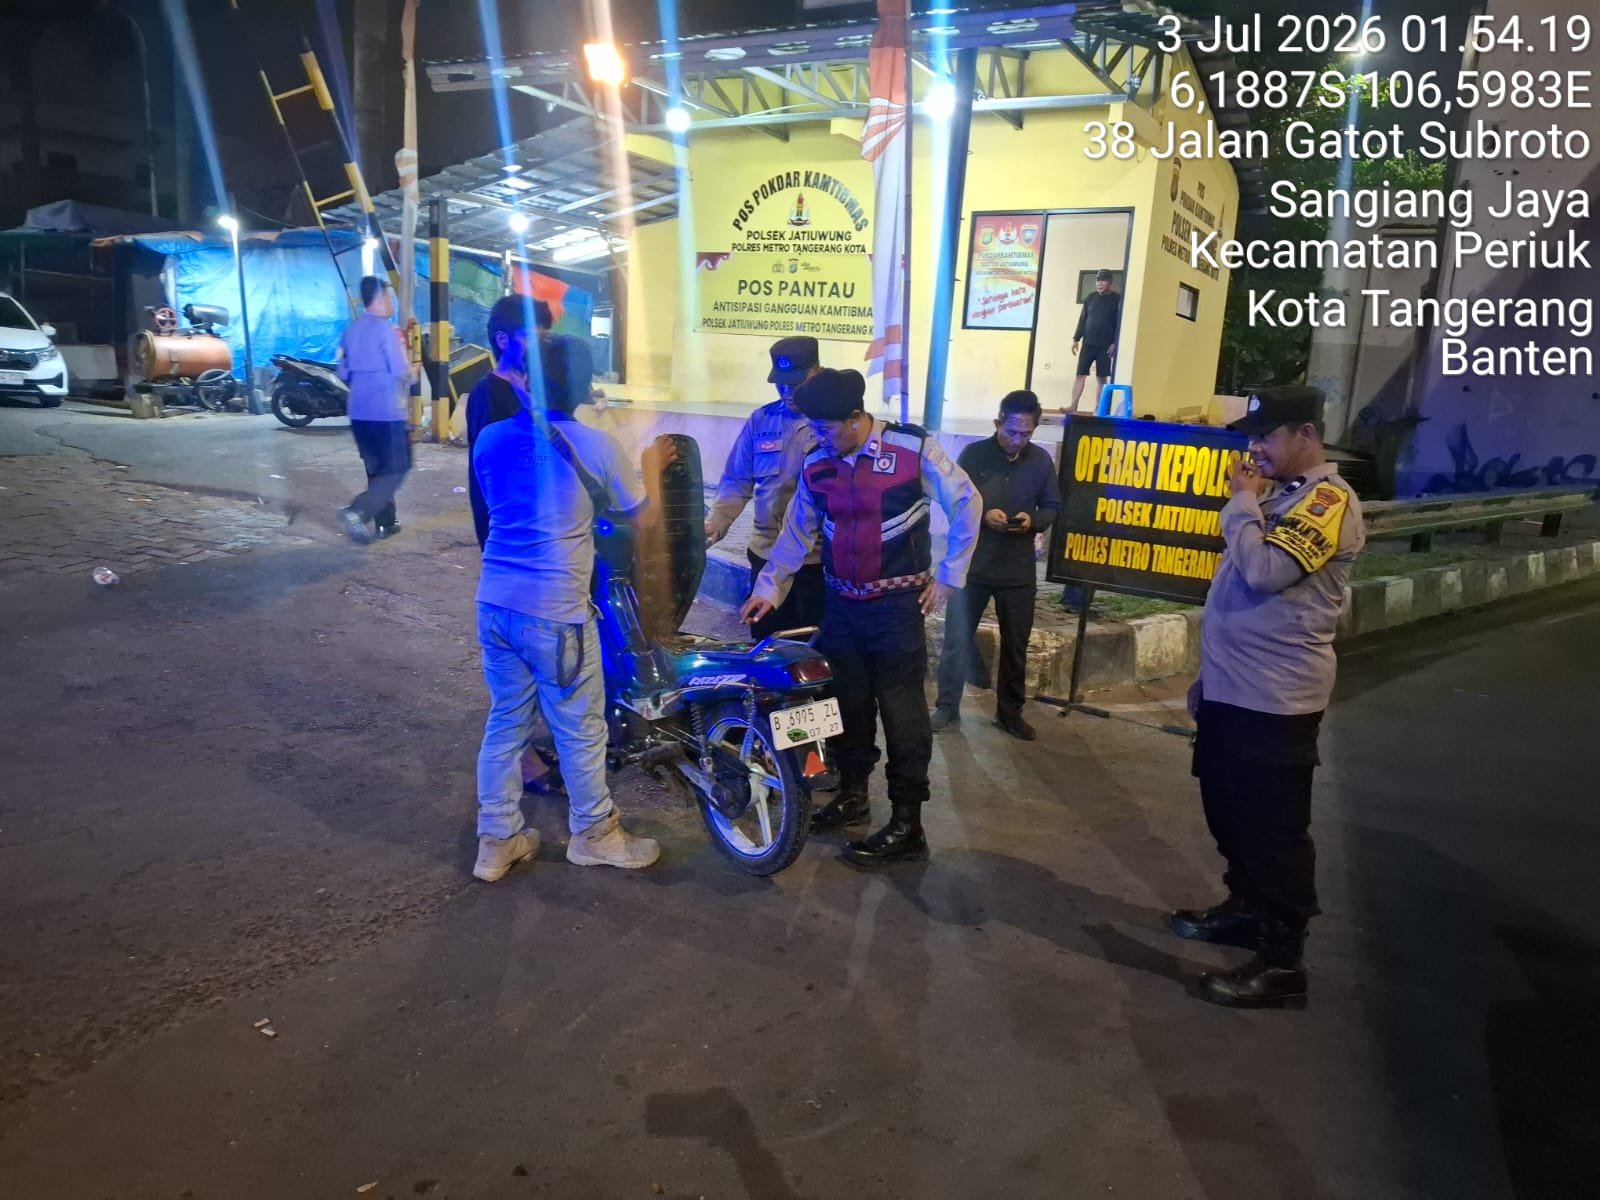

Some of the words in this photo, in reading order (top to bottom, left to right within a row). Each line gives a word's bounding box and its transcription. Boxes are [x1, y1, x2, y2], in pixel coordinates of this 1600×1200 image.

[732, 199, 754, 231] POS
[752, 170, 800, 206] POKDAR
[746, 230, 786, 241] POLSEK
[788, 230, 852, 242] JATIUWUNG
[732, 242, 761, 252] POLRES
[762, 243, 791, 253] METRO
[792, 243, 843, 254] TANGERANG
[844, 243, 867, 254] KOTA
[738, 279, 773, 296] POS
[778, 280, 855, 299] PANTAU
[712, 301, 762, 313] ANTISIPASI
[763, 302, 818, 315] GANGGUAN
[819, 304, 874, 318] KAMTIBMA
[702, 317, 726, 329] POLSEK
[795, 321, 821, 333] METRO
[821, 322, 868, 336] TANGERANG
[1074, 434, 1158, 490] OPERASI
[1155, 443, 1253, 499] KEPOLIS
[1095, 497, 1153, 528] POLSEK
[1152, 504, 1223, 537] JATIUWU
[1063, 532, 1109, 565] POLRES
[1108, 538, 1150, 571] METRO
[773, 716, 781, 731] B
